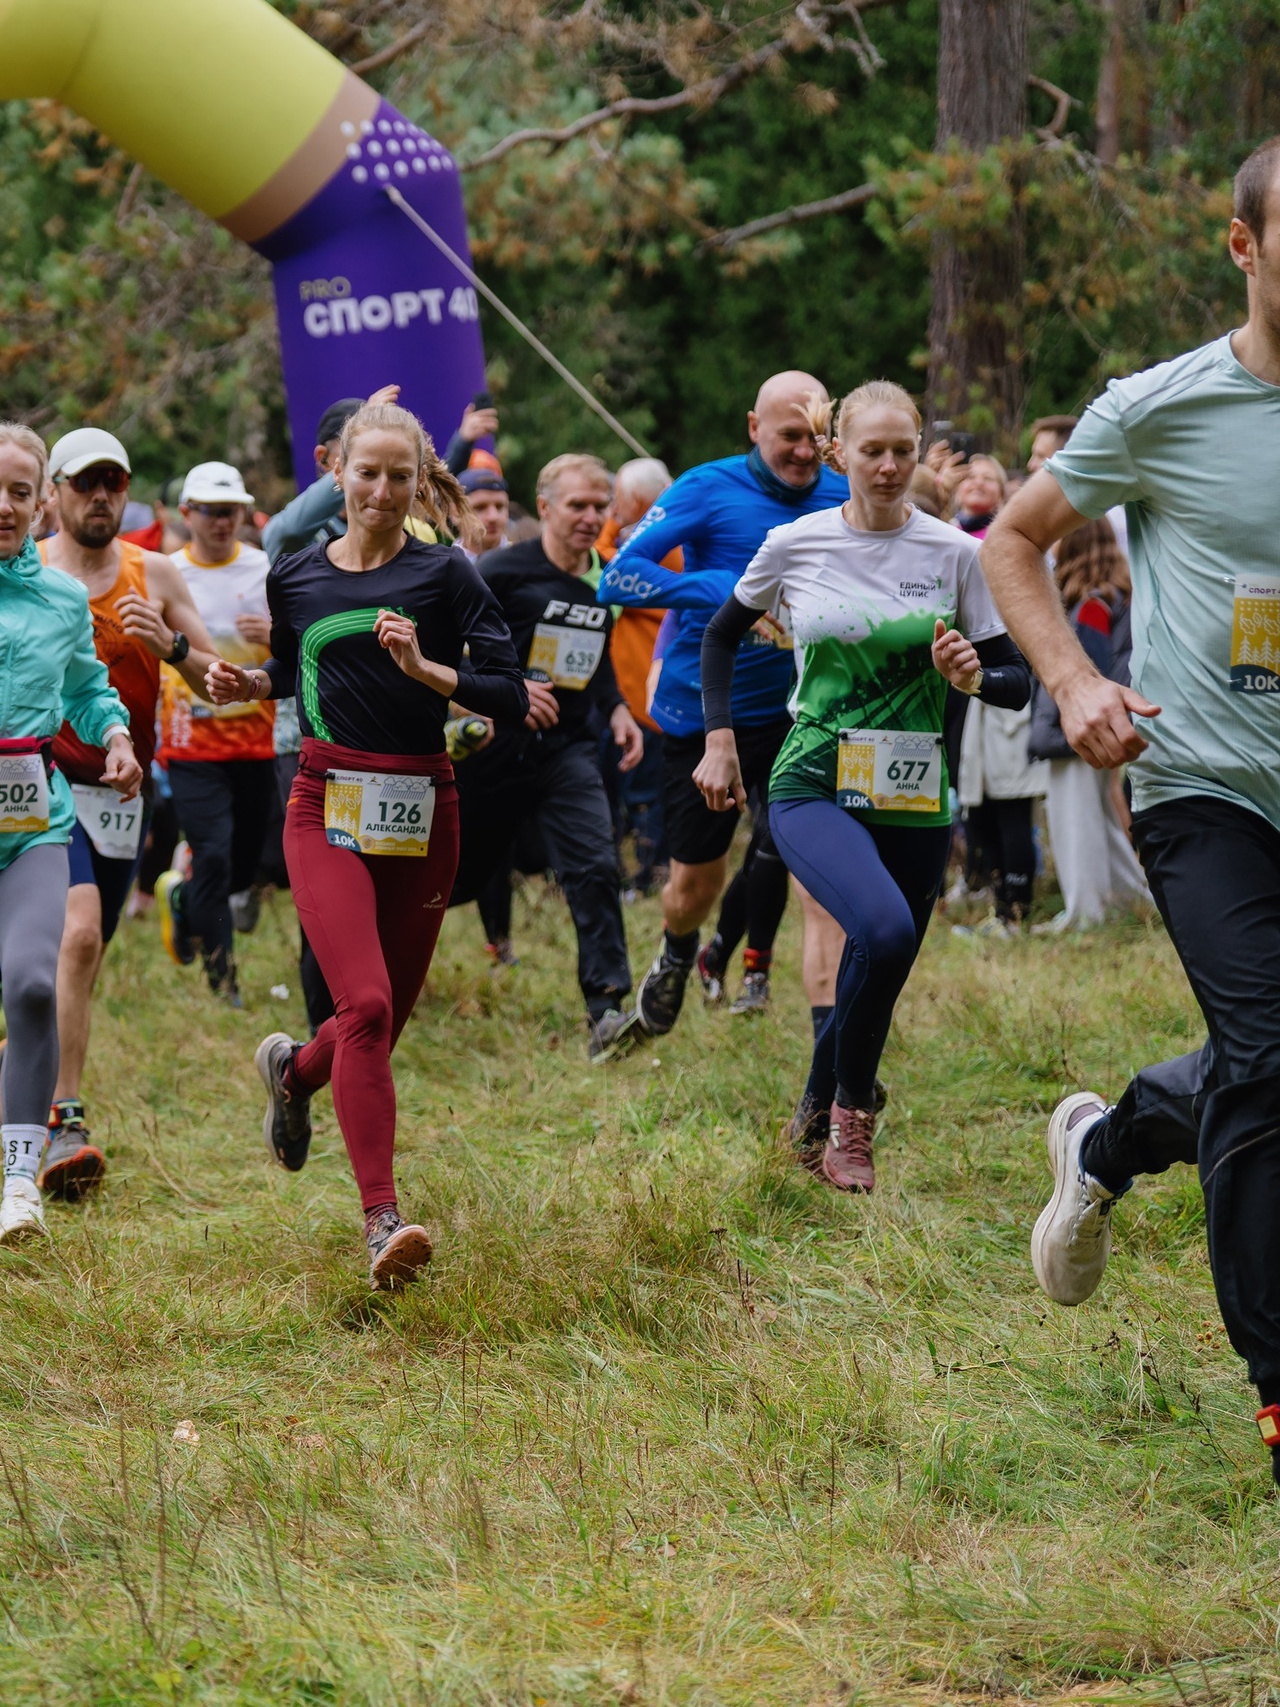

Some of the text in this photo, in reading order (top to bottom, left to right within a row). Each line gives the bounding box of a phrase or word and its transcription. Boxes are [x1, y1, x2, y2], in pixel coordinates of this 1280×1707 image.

[303, 288, 446, 338] СПОРТ
[899, 581, 936, 591] ЕДИНЫЙ
[899, 590, 929, 598] ЦУПИС
[566, 650, 595, 667] 639
[887, 760, 930, 781] 677
[895, 782, 919, 790] АННА
[3, 805, 29, 813] АННА
[378, 801, 422, 824] 126
[100, 811, 136, 831] 917
[365, 823, 427, 835] АЛЕКСАНДРА
